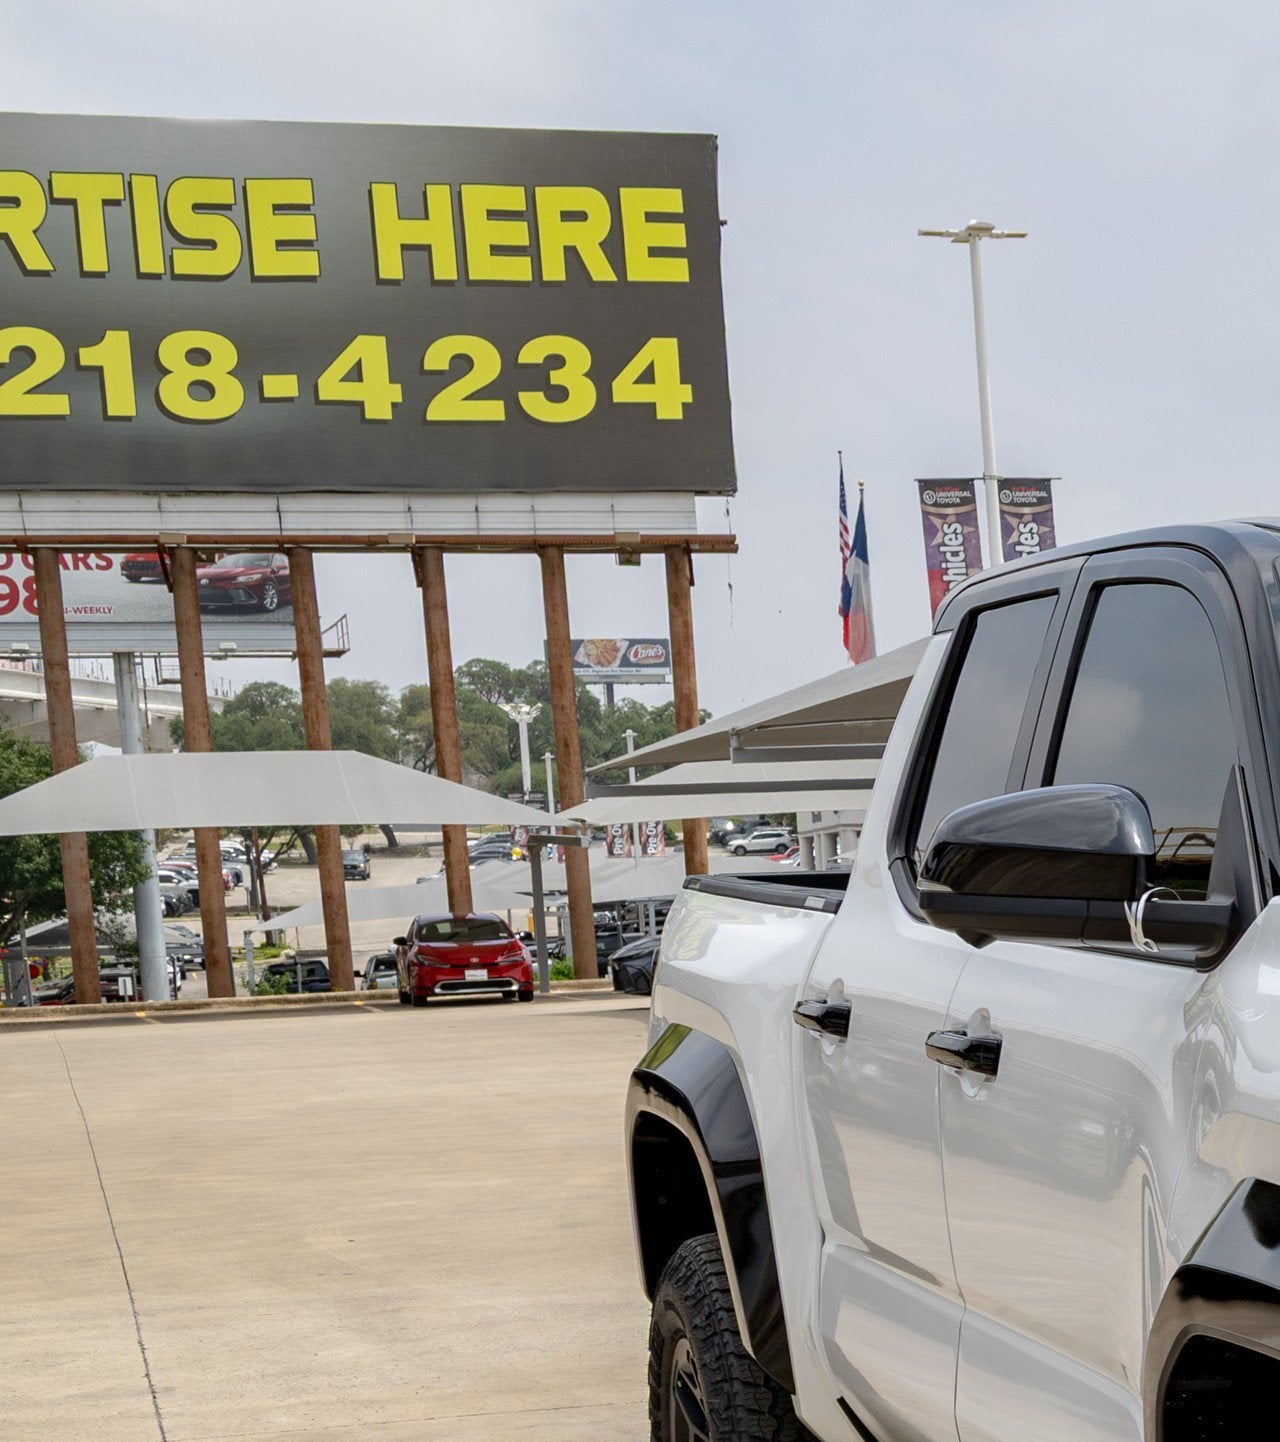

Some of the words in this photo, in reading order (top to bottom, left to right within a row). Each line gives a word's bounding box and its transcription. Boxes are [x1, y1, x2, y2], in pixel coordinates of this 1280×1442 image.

[369, 182, 690, 282] HERE
[0, 326, 694, 423] 218-4234
[936, 490, 971, 498] UNIVERSAL
[1012, 490, 1048, 498] UNIVERSAL
[939, 522, 970, 594] hicles
[62, 606, 113, 615] I-WEEKLY
[614, 836, 624, 854] Pre
[647, 836, 658, 854] Pre
